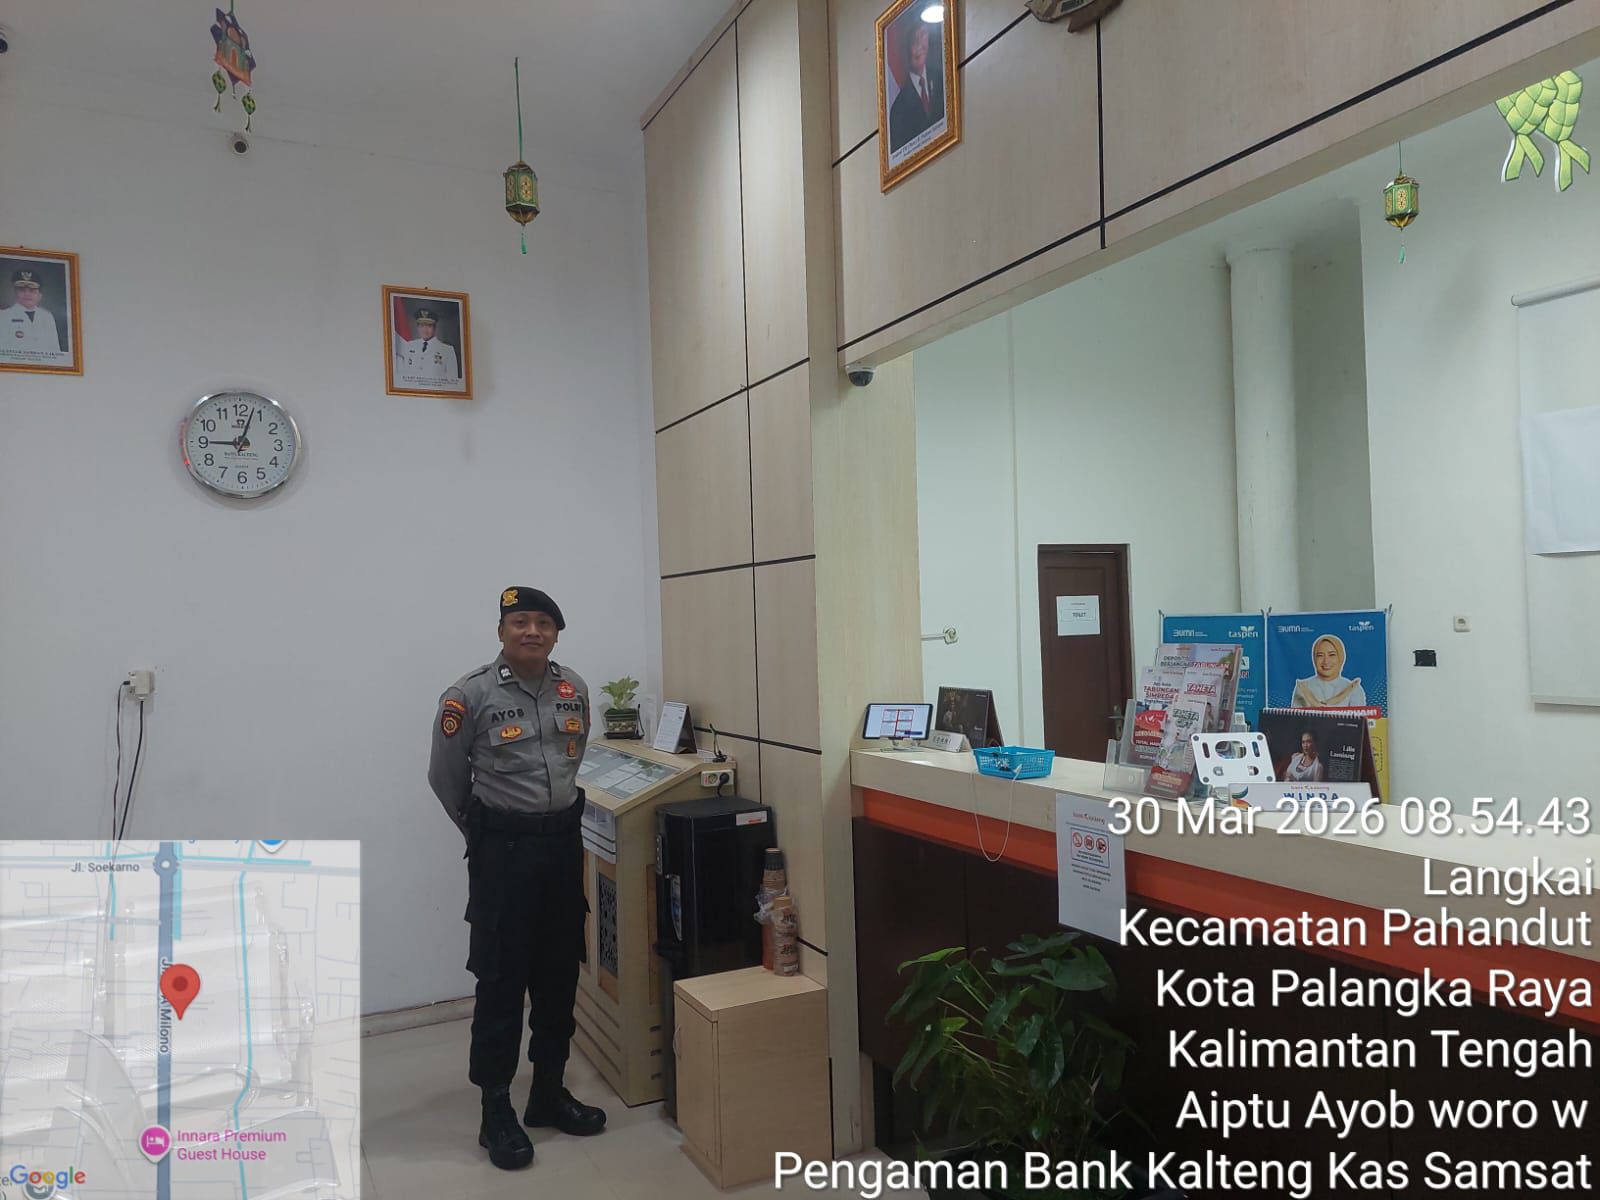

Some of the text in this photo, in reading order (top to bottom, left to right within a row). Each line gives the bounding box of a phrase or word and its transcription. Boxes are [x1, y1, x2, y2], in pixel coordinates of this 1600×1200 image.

[216, 407, 228, 420] 11
[232, 404, 248, 417] 12
[257, 409, 263, 422] 1
[200, 418, 216, 432] 10
[268, 422, 278, 435] 2
[198, 436, 209, 449] 9
[273, 439, 284, 452] 3
[204, 453, 214, 467] 8
[269, 455, 279, 468] 4
[218, 466, 228, 479] 7
[237, 471, 248, 484] 6
[256, 467, 266, 480] 5
[1228, 630, 1259, 638] taspen
[1348, 624, 1374, 632] taspen
[1143, 686, 1180, 694] TABUNGAN
[491, 708, 525, 723] AYOB
[1283, 792, 1339, 801] WINDA
